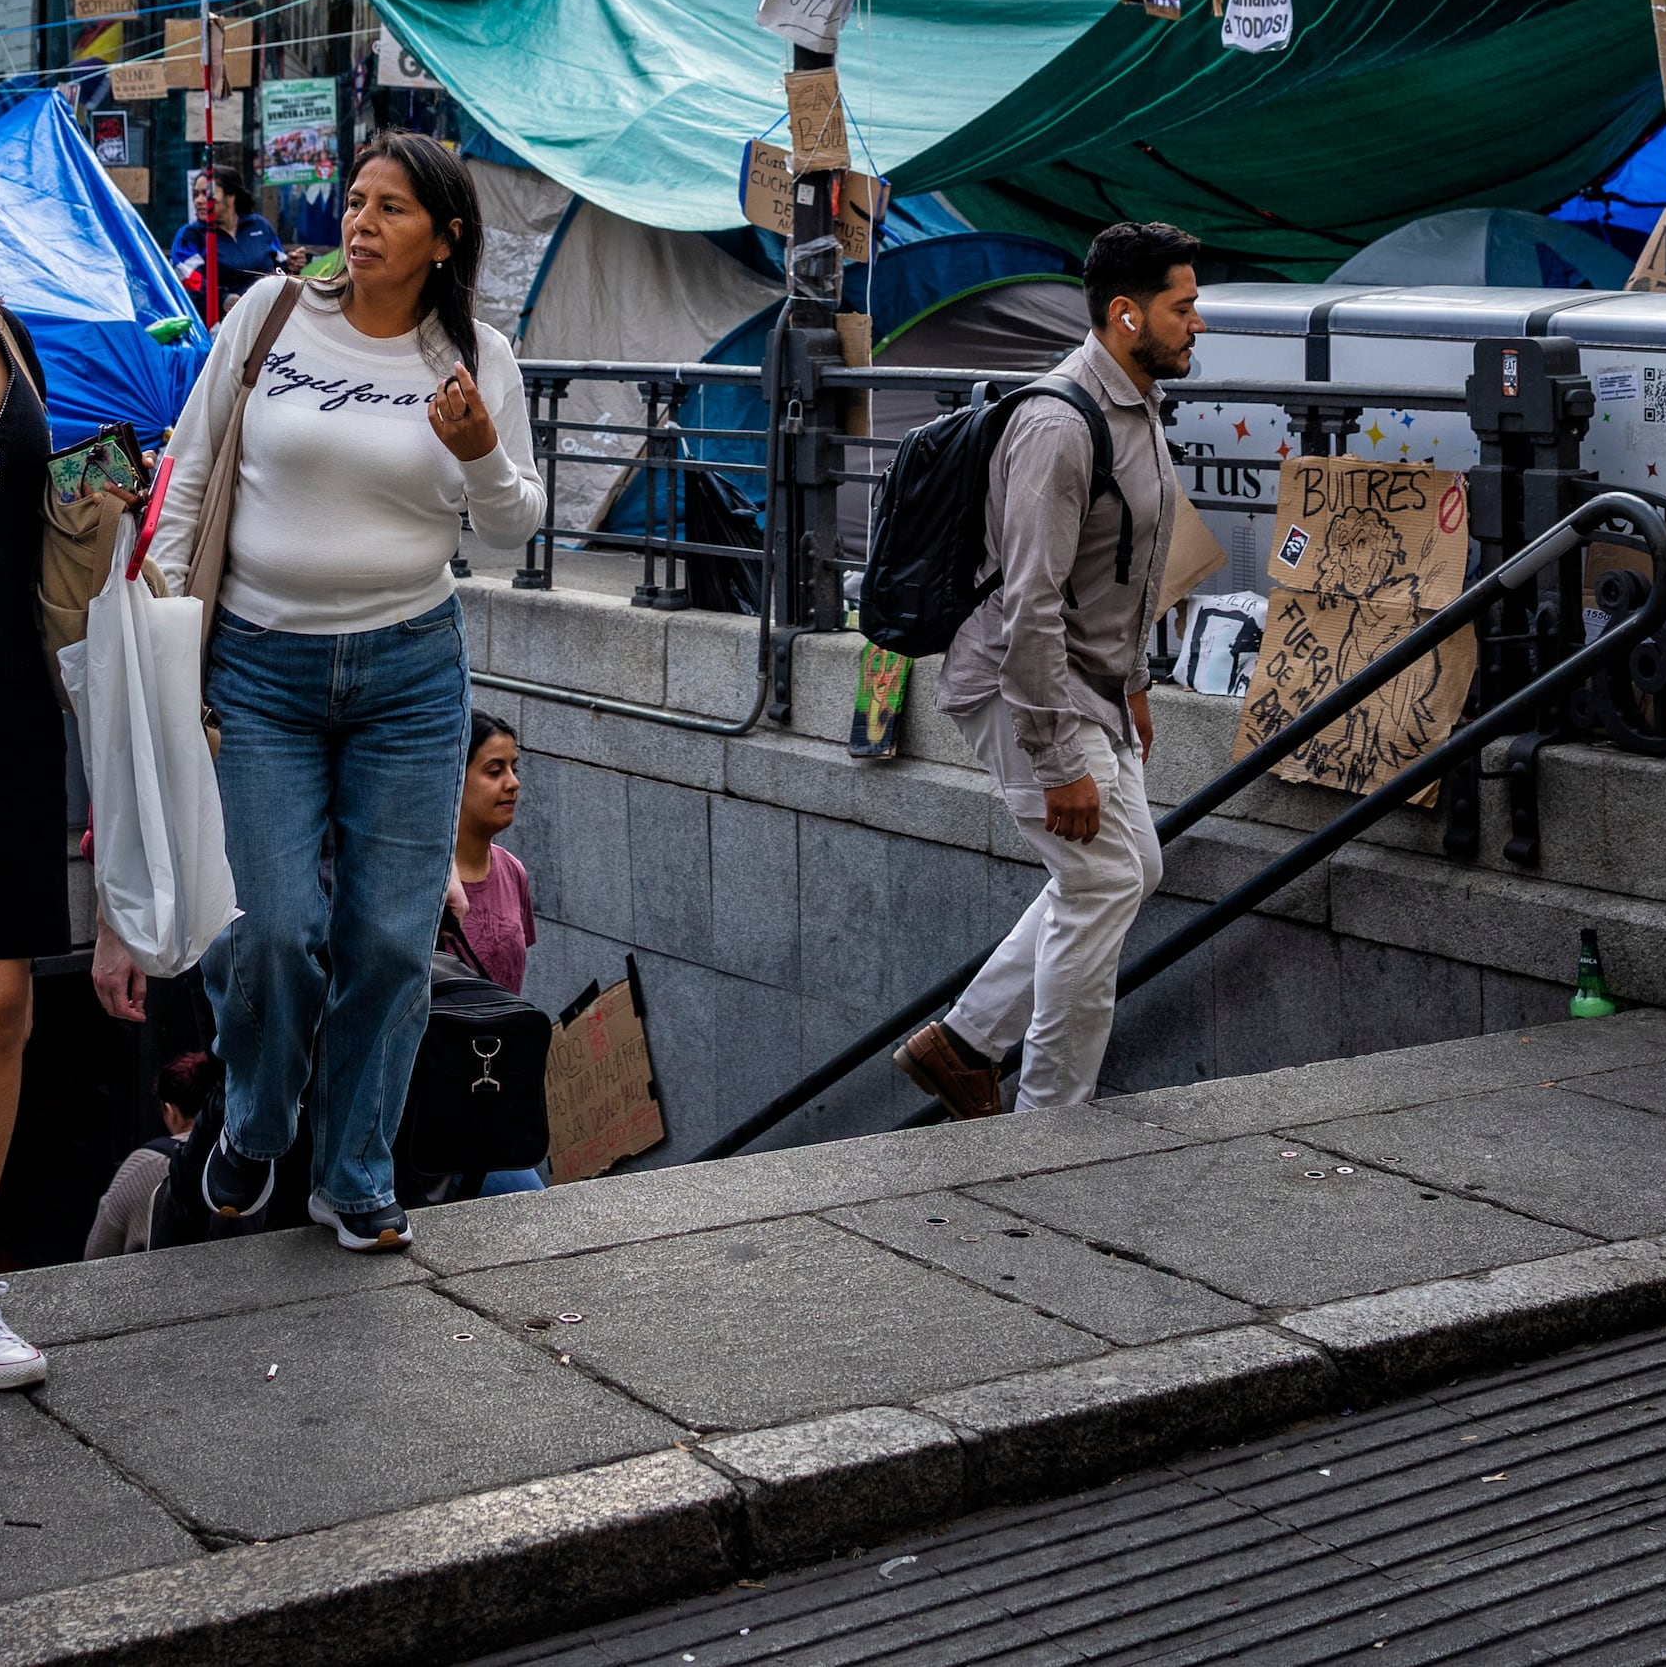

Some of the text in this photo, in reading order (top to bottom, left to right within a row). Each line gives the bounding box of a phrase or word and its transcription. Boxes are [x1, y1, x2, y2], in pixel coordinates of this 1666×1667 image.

[1224, 14, 1288, 39] a TODOS!
[262, 351, 419, 411] Angel for a
[1185, 442, 1262, 499] Tus
[1294, 468, 1430, 518] BUITRES
[1278, 598, 1332, 696] FUERA
